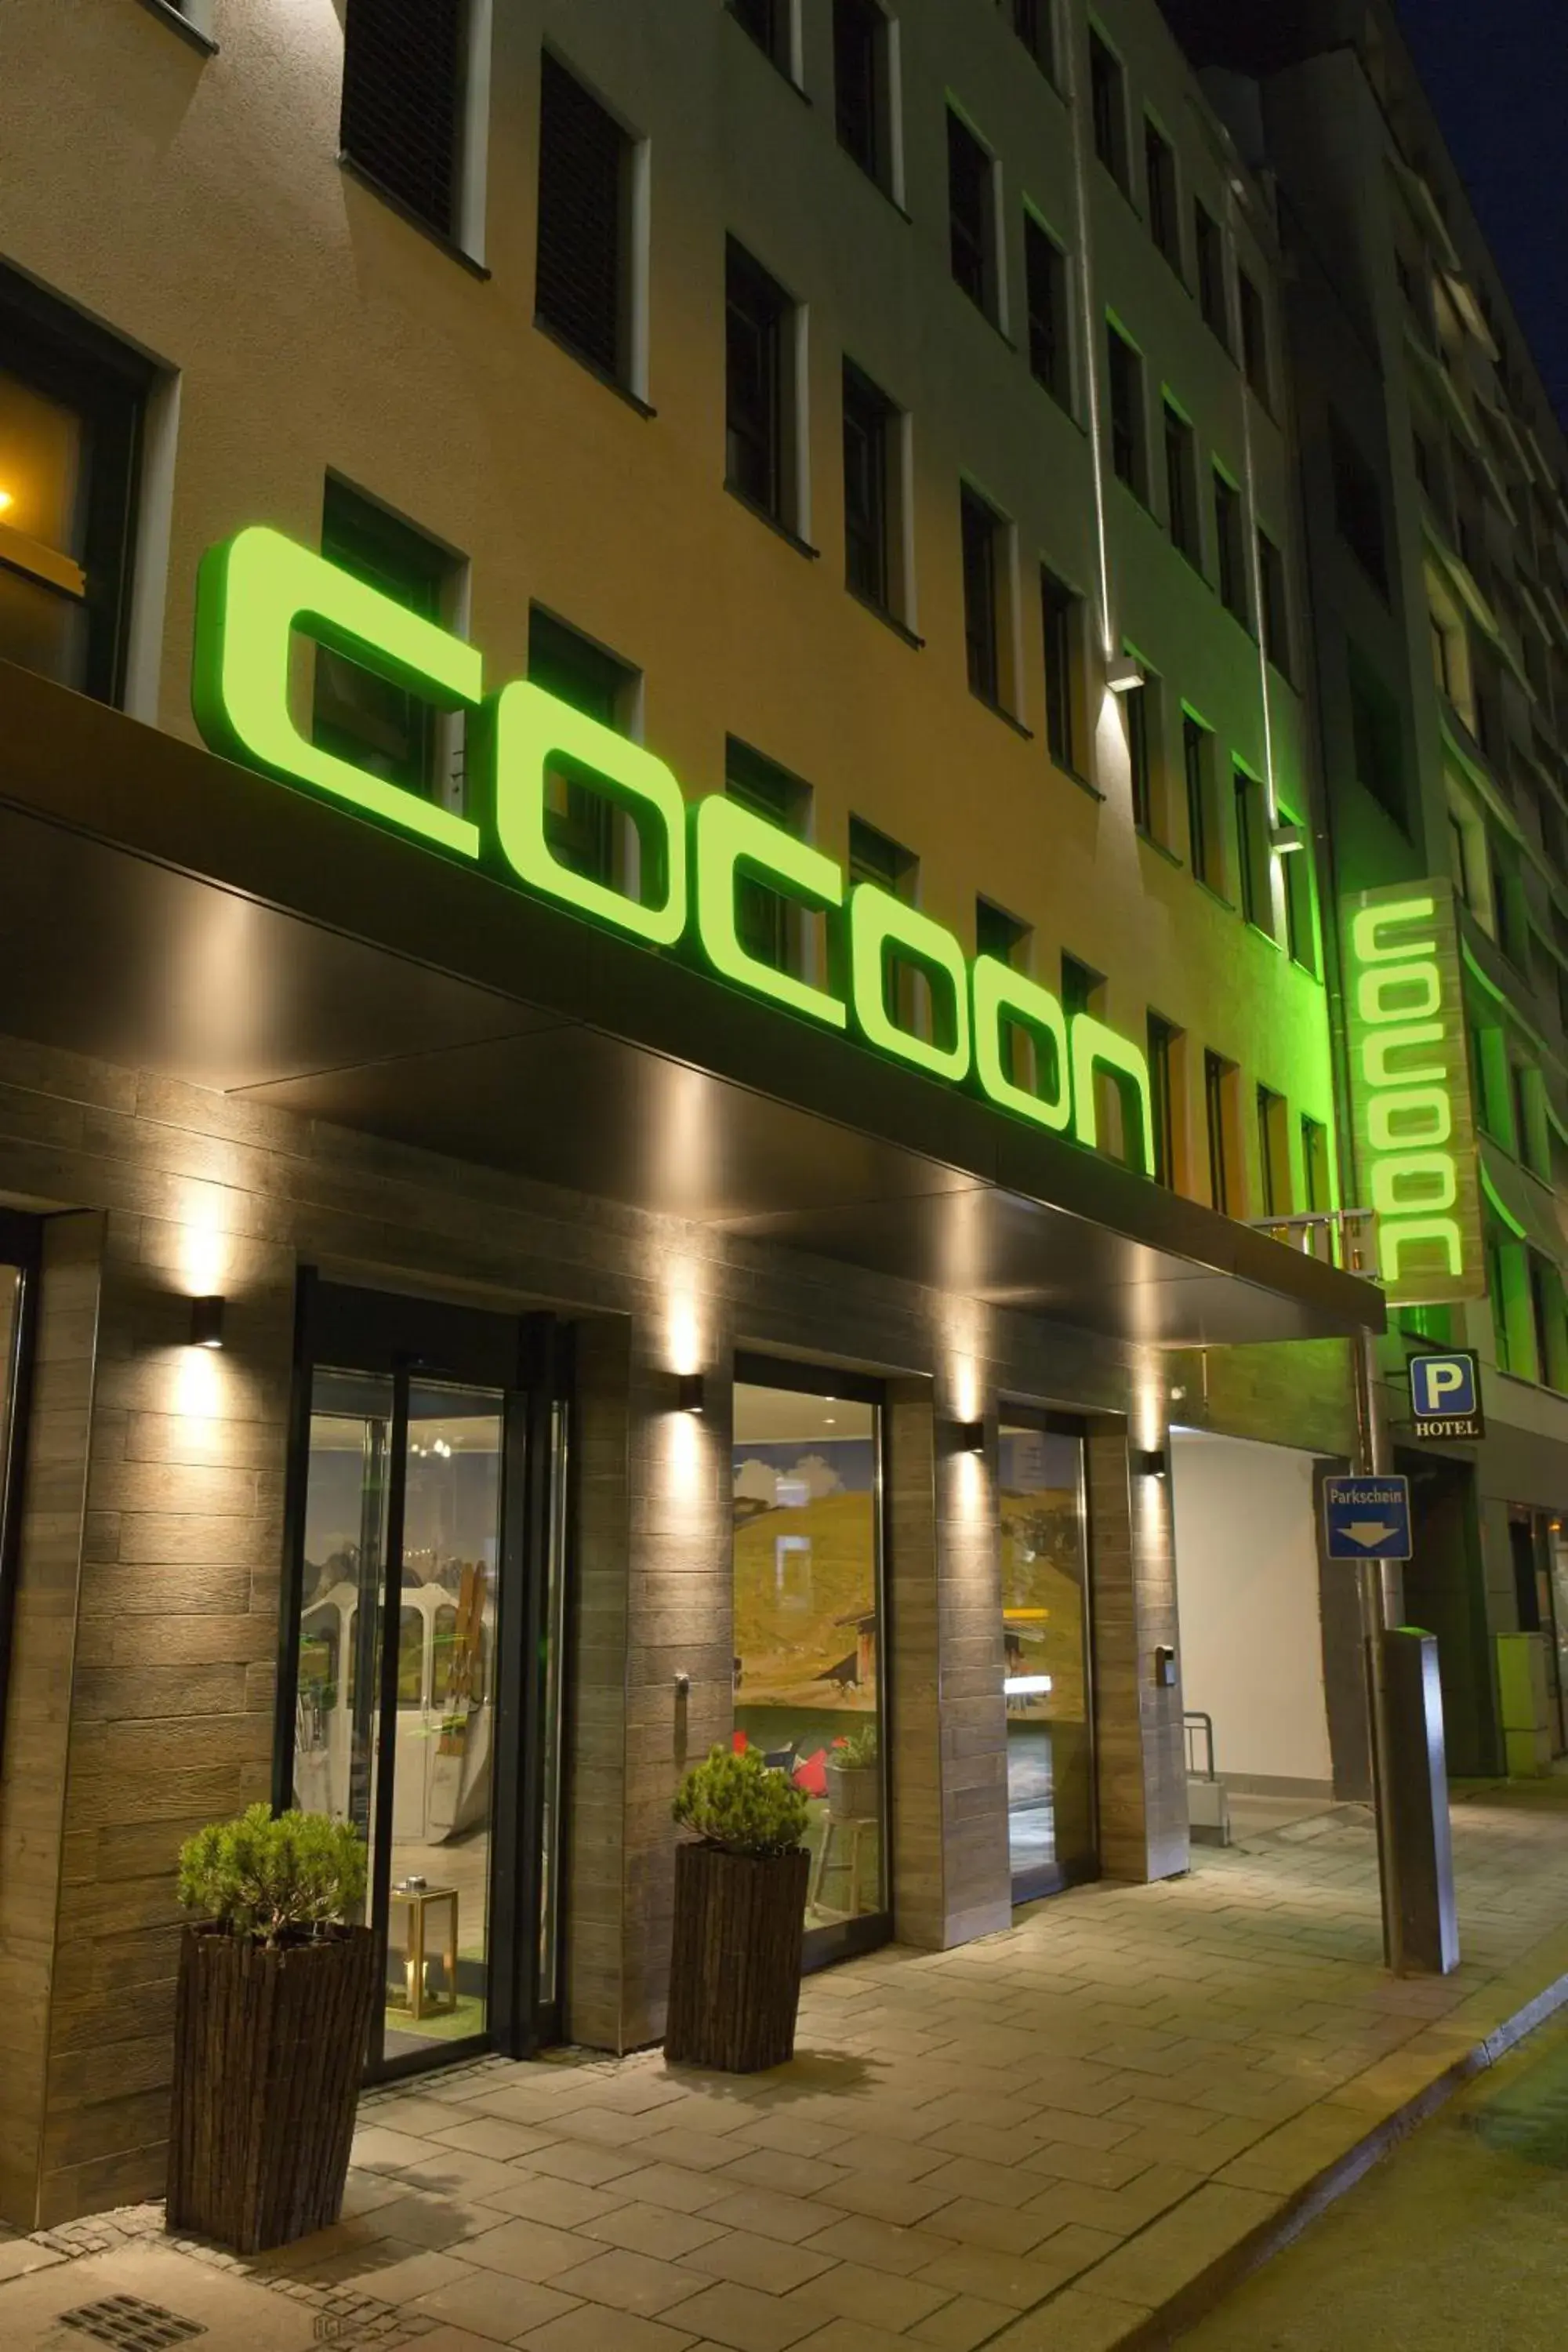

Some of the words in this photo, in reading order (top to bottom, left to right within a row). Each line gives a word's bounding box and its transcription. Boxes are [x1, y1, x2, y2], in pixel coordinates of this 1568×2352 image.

[1425, 1362, 1464, 1410] P
[1416, 1421, 1479, 1437] HOTEL
[1330, 1487, 1403, 1504] Parkschein
